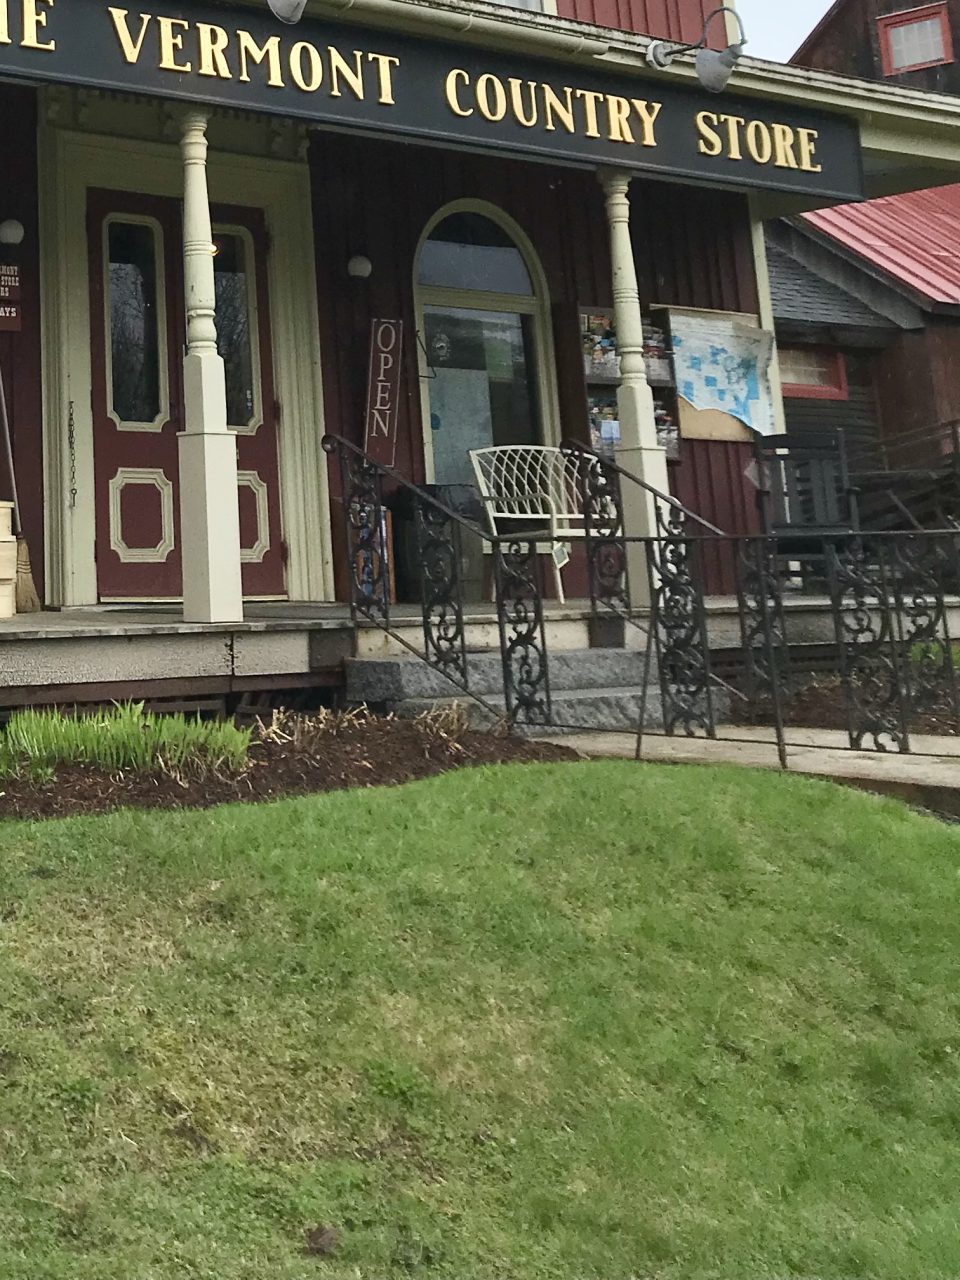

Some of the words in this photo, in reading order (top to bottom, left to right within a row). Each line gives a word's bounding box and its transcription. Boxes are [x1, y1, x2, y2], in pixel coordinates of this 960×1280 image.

[108, 6, 400, 106] VERMONT
[445, 68, 662, 147] COUNTRY
[696, 110, 823, 173] STORE
[1, 275, 19, 286] STORE
[371, 323, 396, 437] OPEN
